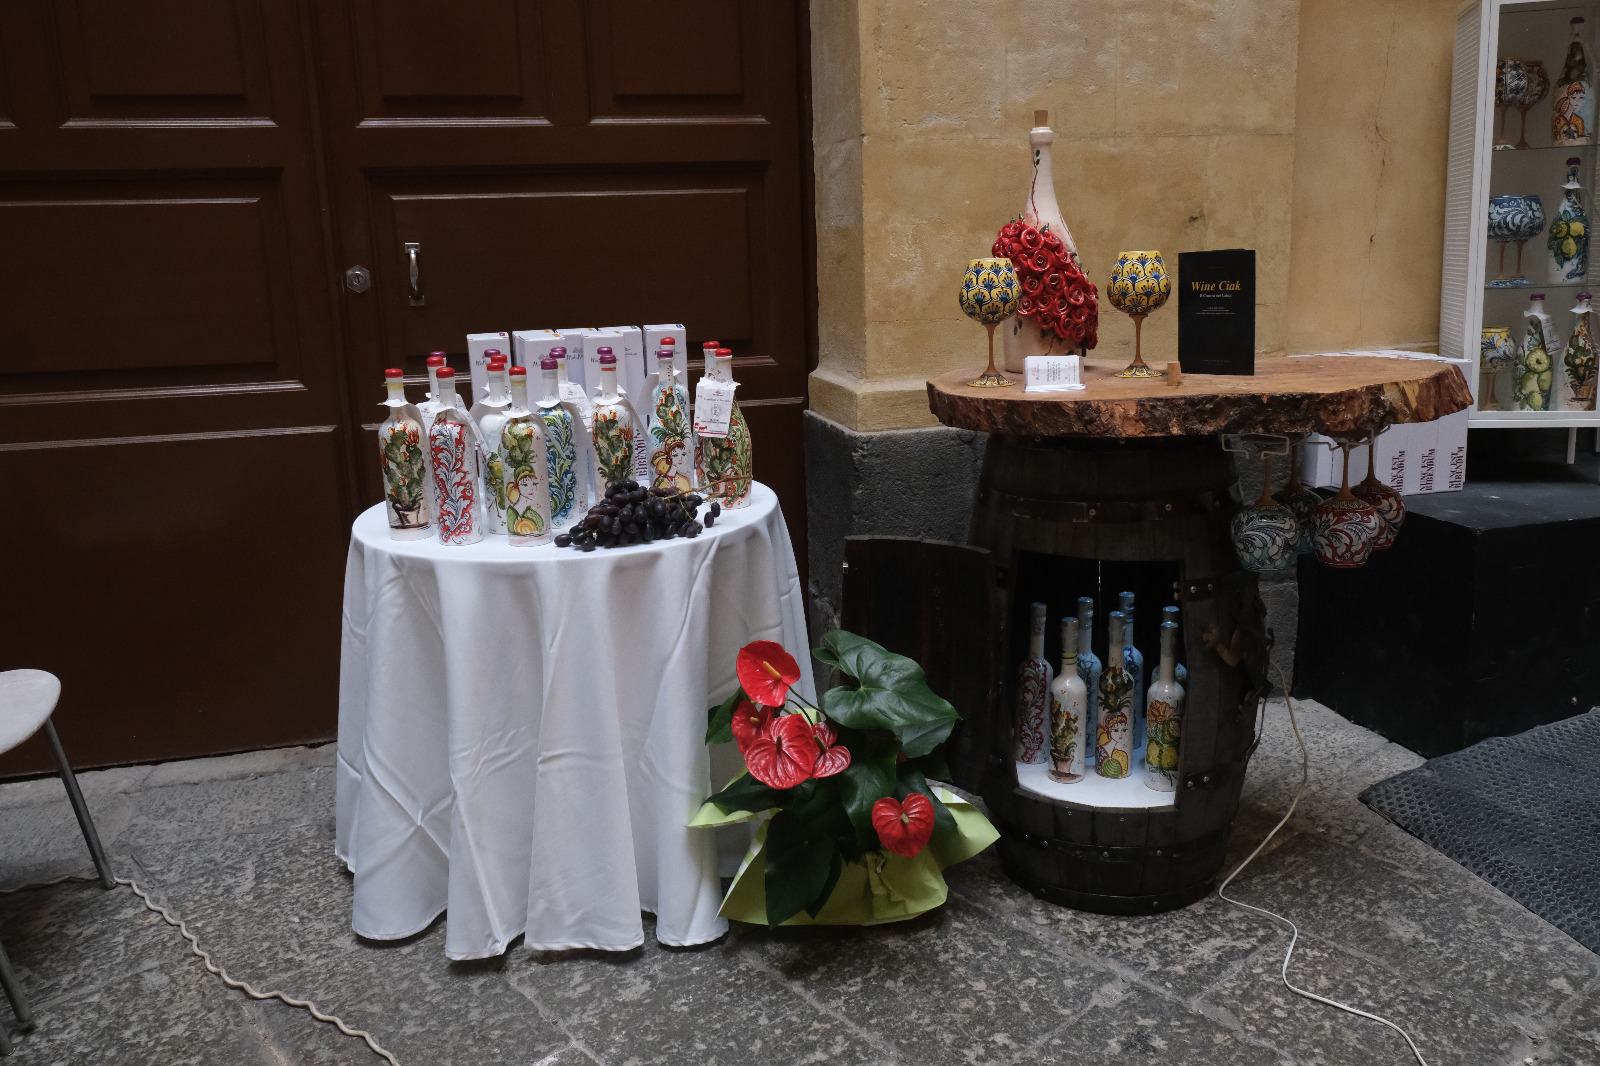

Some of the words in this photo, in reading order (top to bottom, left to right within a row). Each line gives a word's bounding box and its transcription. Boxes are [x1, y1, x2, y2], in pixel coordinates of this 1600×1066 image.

[1191, 281, 1216, 292] Wine
[1218, 280, 1241, 291] Ciak
[1391, 455, 1400, 471] EST
[1421, 453, 1429, 469] EST
[1450, 451, 1458, 466] EST
[1454, 446, 1464, 488] BIBENDUM
[1396, 450, 1406, 493] BIBENDUM
[1425, 448, 1436, 491] BIBENDUM
[1448, 467, 1456, 489] NUNC
[1390, 472, 1398, 490] UNC
[1420, 470, 1428, 491] NUNC
